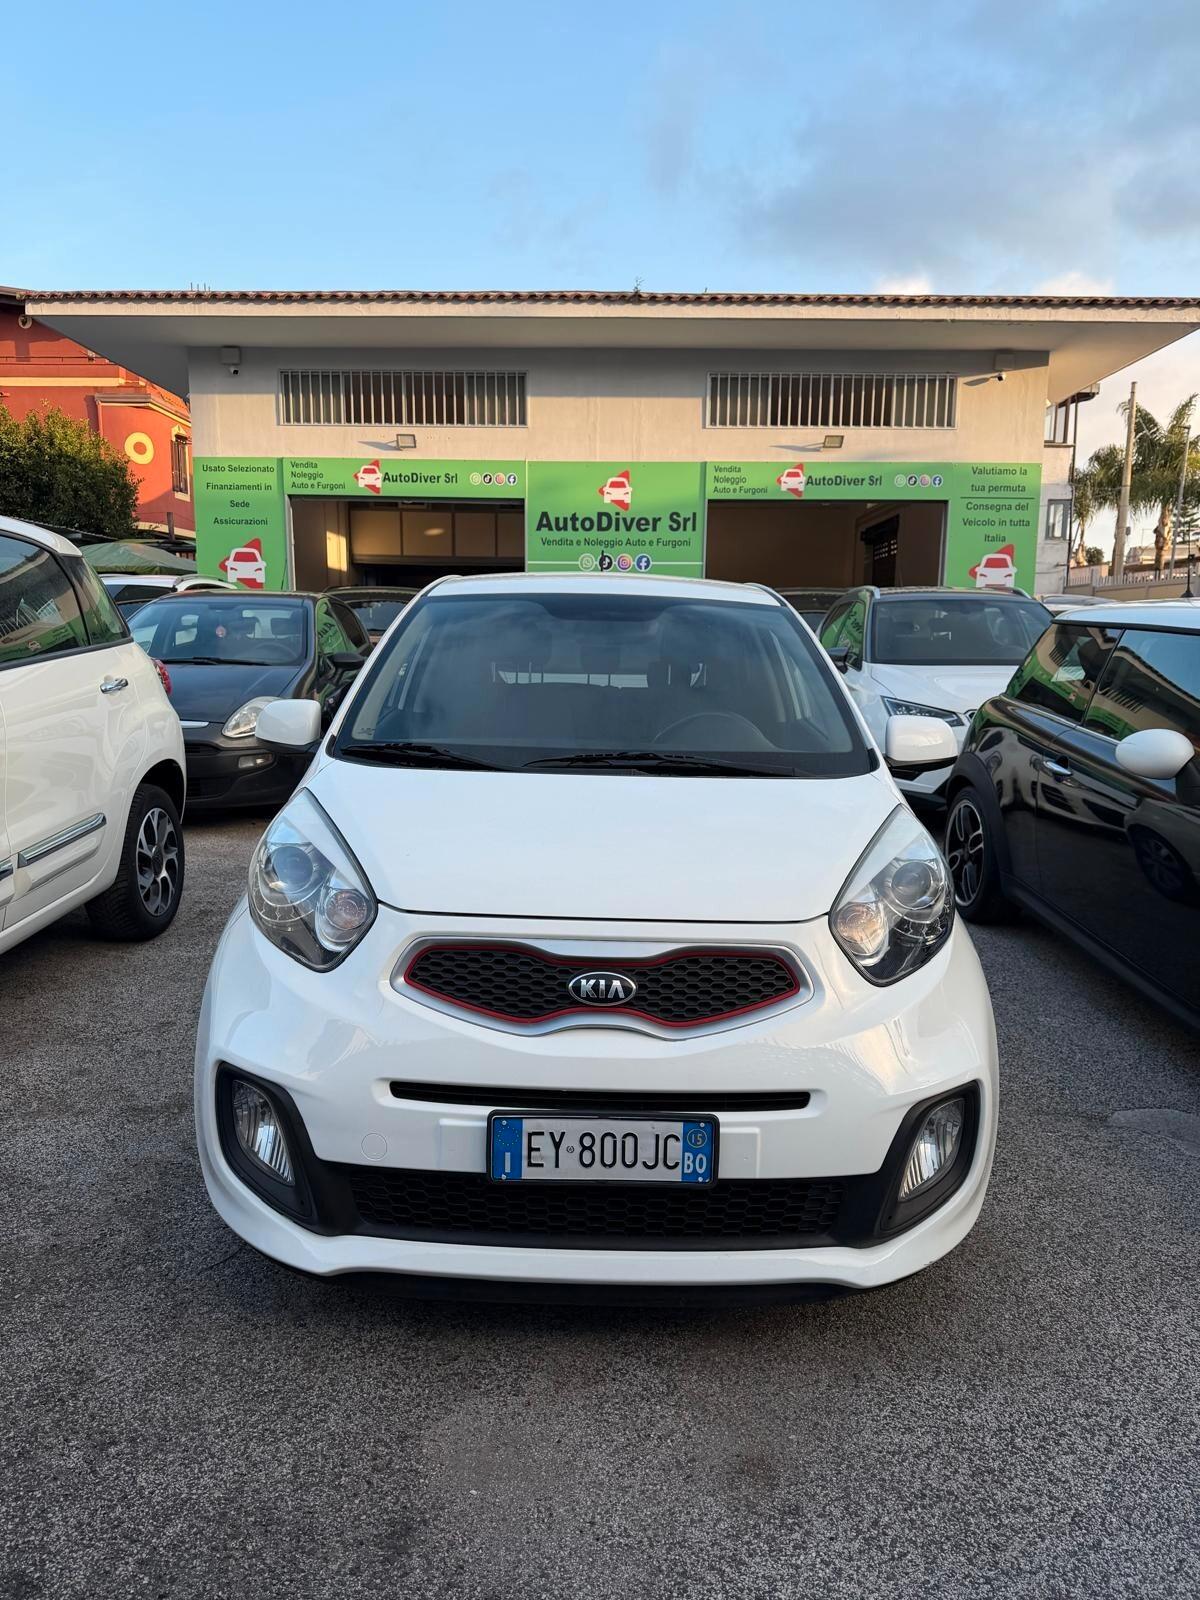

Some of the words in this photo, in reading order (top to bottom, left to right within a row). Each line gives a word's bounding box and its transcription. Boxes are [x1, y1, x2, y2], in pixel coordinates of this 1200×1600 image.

[202, 464, 226, 472] Usato
[227, 464, 274, 473] Selezionato
[290, 461, 318, 469] Vendita
[714, 465, 741, 473] Vendita
[291, 471, 324, 480] Noleggio
[971, 466, 1017, 476] Valutiamo
[1019, 467, 1028, 476] la
[382, 472, 441, 484] AutoDiver
[444, 473, 458, 484] Srl
[713, 475, 747, 485] Noleggio
[806, 475, 864, 487] AutoDiver
[867, 475, 882, 486] Srl
[206, 482, 263, 491] Finanziamenti
[264, 483, 272, 491] in
[291, 481, 309, 489] Auto
[316, 482, 346, 491] Furgoni
[713, 486, 731, 494] Auto
[739, 486, 768, 496] Furgoni
[971, 484, 986, 492] tua
[988, 484, 1026, 493] permuta
[230, 500, 250, 508] Sede
[966, 502, 1013, 513] Consegna
[1014, 502, 1029, 511] del
[213, 517, 268, 525] Assicurazioni
[535, 511, 662, 532] AutoDiver
[668, 511, 697, 532] Srl
[962, 518, 996, 527] Veicolo
[998, 518, 1007, 527] in
[1009, 519, 1031, 527] tutta
[541, 537, 574, 547] Vendita
[576, 539, 581, 547] e
[584, 537, 623, 549] Noleggio
[625, 538, 647, 547] Auto
[656, 538, 691, 549] Furgoni
[984, 534, 1006, 542] Italia
[580, 979, 625, 999] KIA
[526, 1131, 566, 1169] EY
[578, 1131, 681, 1170] 800JC
[683, 1152, 707, 1173] BO
